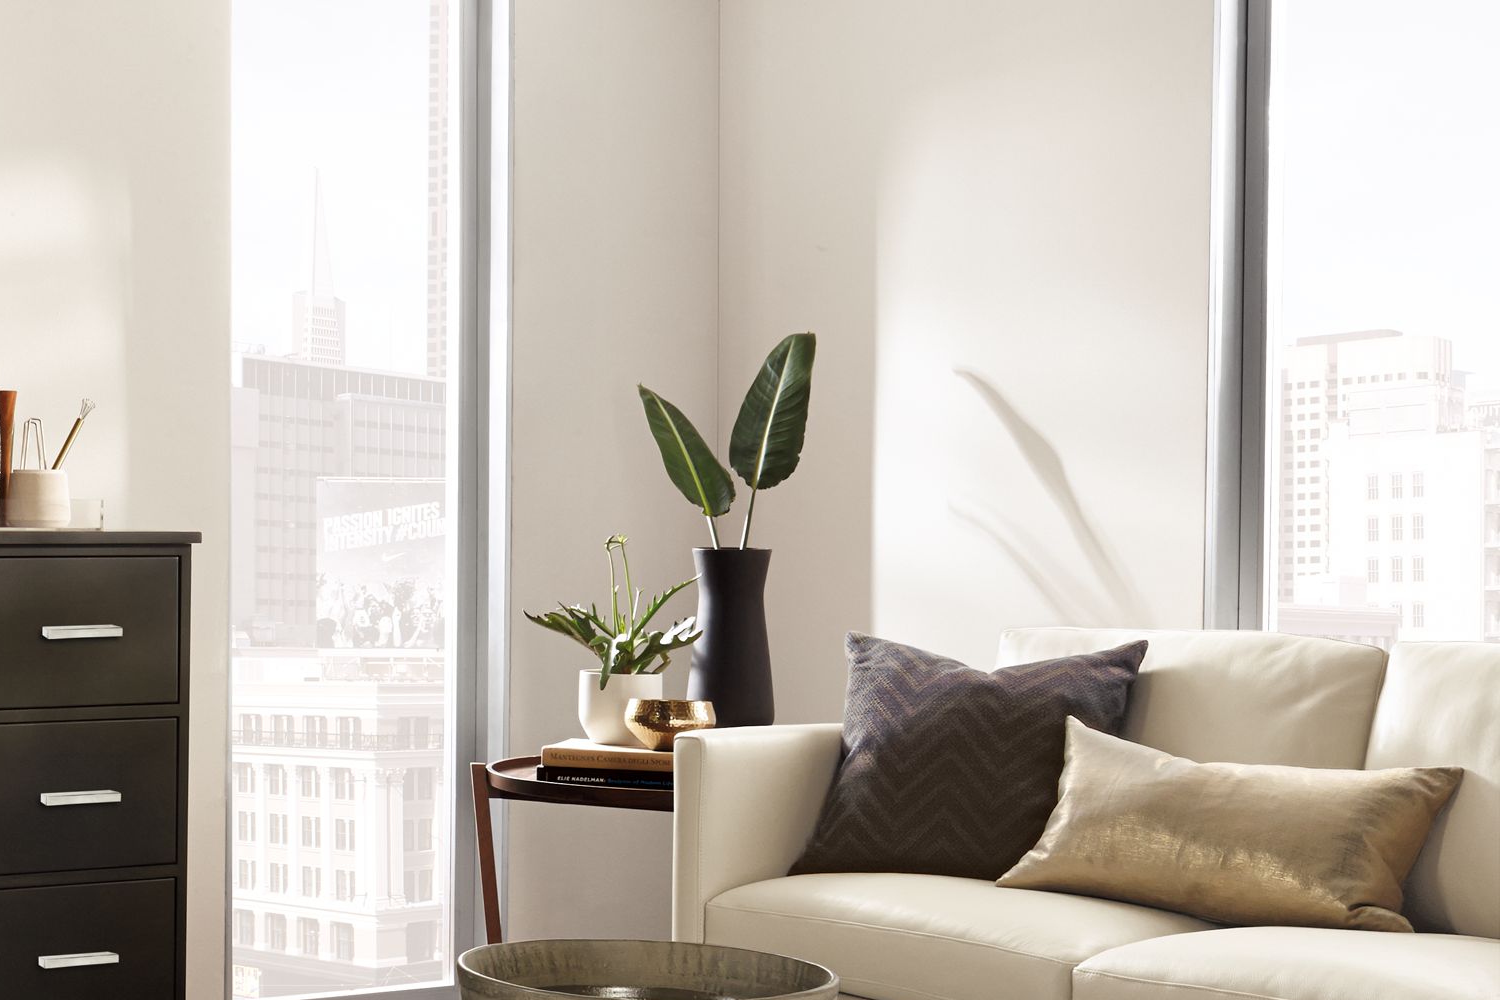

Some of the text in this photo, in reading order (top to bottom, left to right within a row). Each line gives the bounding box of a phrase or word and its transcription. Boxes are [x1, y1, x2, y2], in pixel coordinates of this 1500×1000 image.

[323, 501, 440, 534] PASSION IGNITES
[324, 517, 446, 552] INTENSITY #COUN
